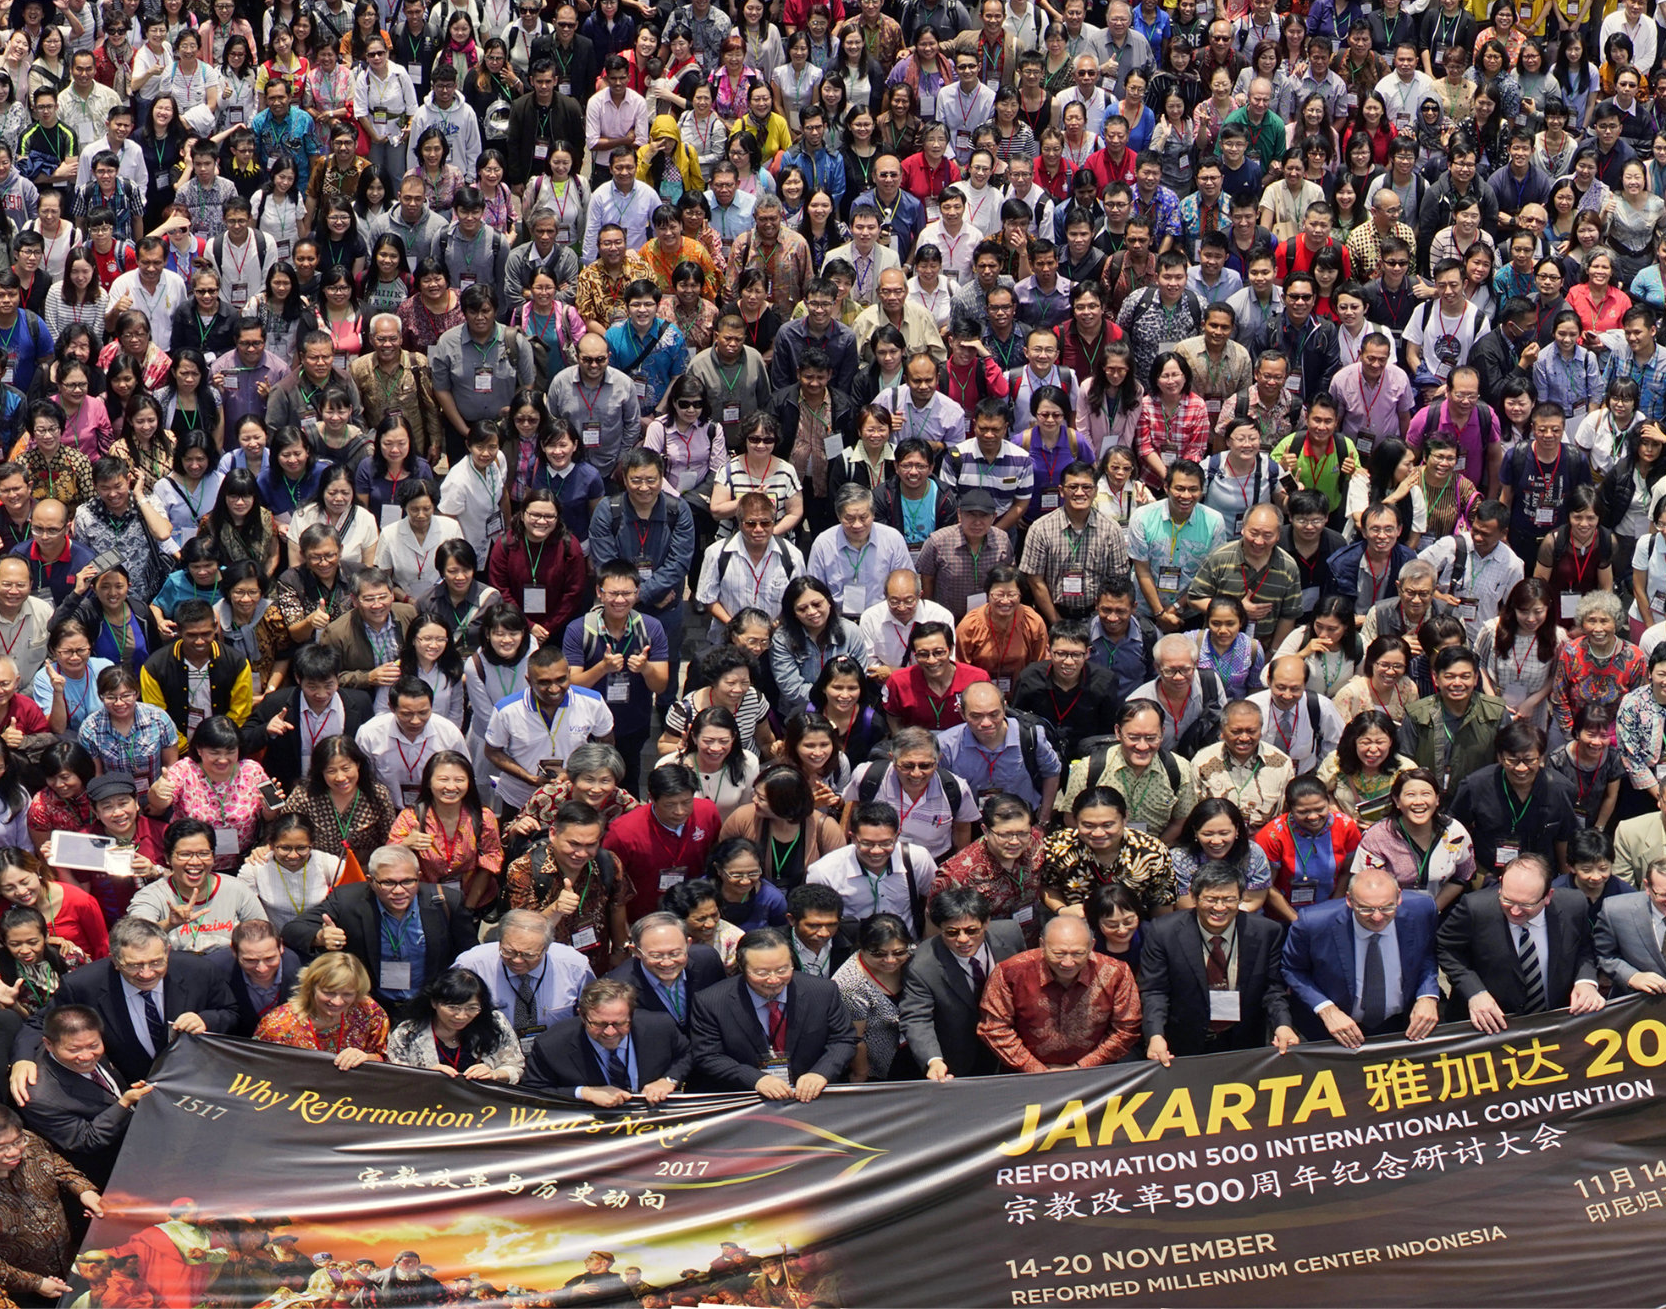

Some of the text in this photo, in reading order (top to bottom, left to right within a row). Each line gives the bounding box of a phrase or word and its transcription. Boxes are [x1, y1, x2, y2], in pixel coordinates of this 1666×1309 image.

[172, 1094, 228, 1121] 1517
[227, 1073, 704, 1148] Why Reformation? What's Next?
[996, 1069, 1347, 1156] JAKARTA
[1363, 1037, 1569, 1113] 雅加达
[996, 1078, 1655, 1186] REFORMATION 500 INTERNATIONAL CONVENTION
[654, 1160, 709, 1177] 2017
[1005, 1233, 1277, 1280] 14-20 NOVEMBER
[1011, 1225, 1507, 1306] REFORMED MILLENNIUM CENTER INDONESIA
